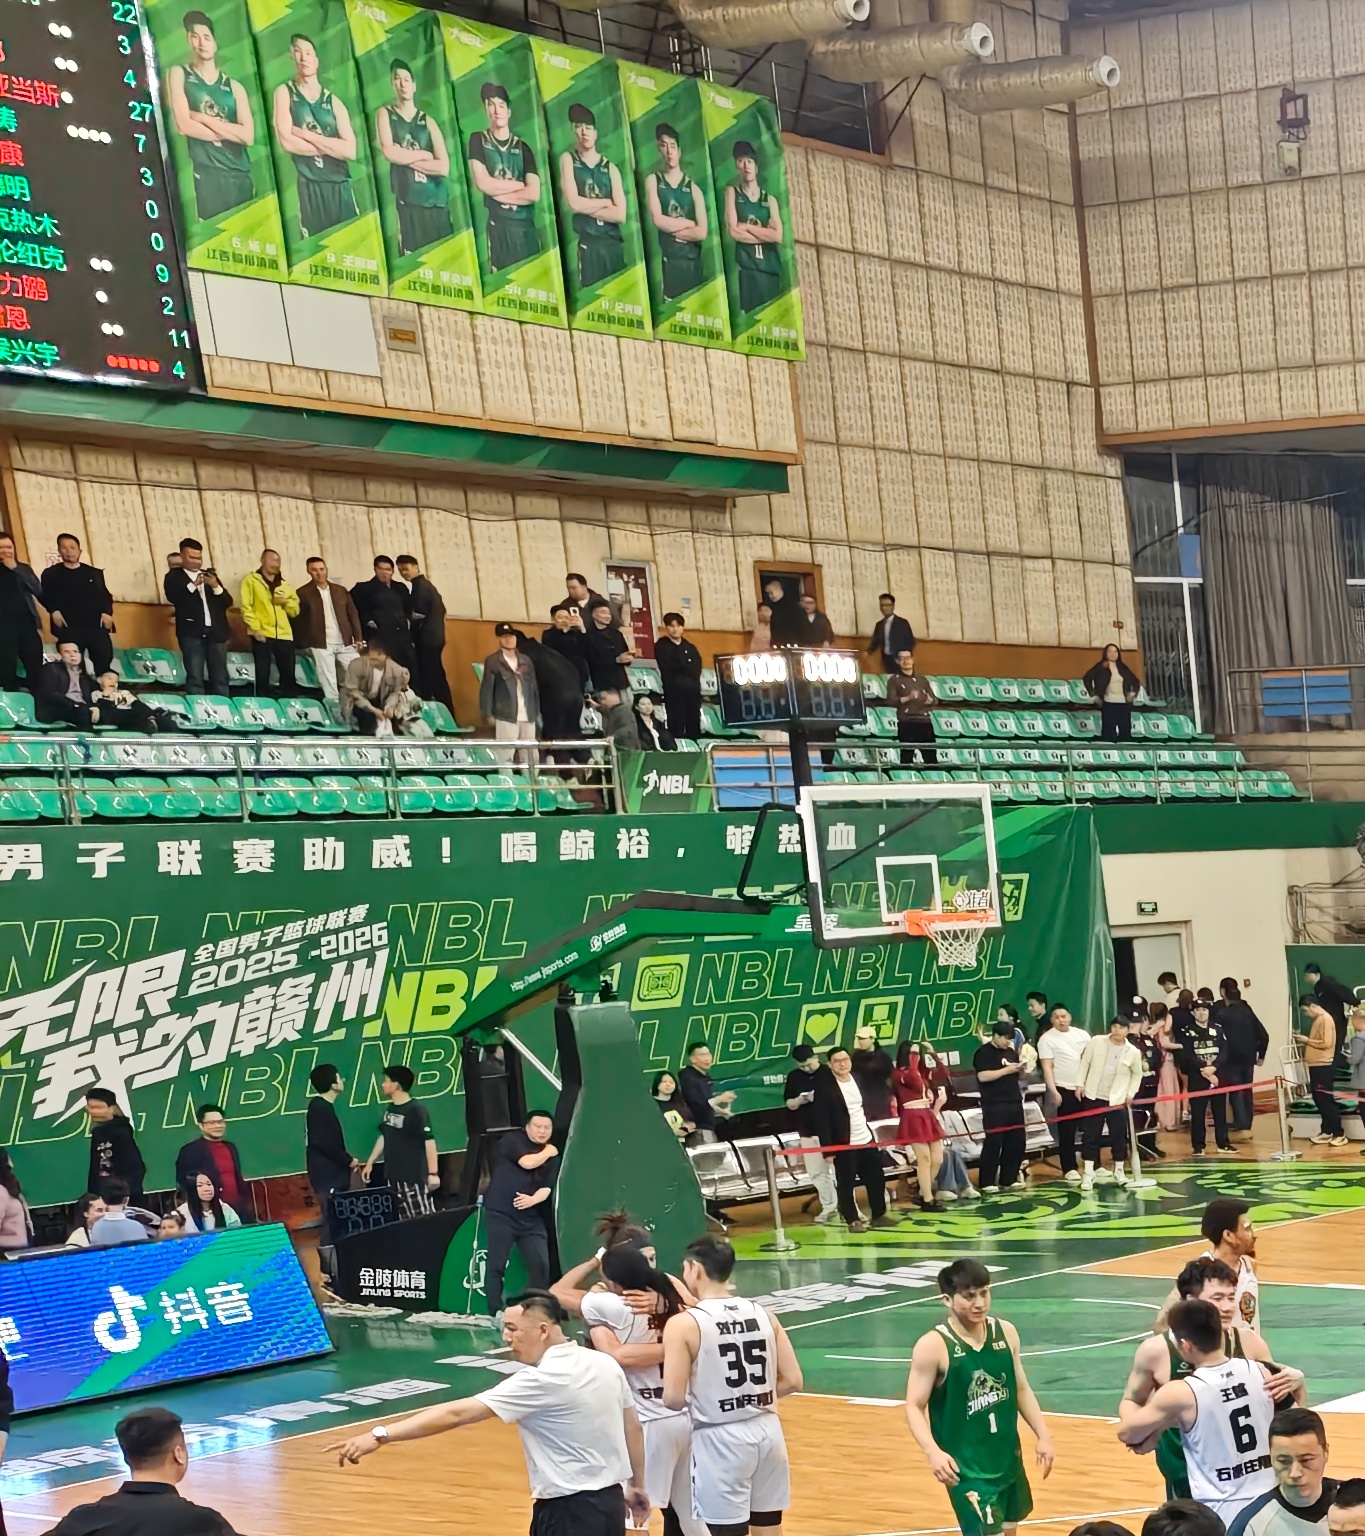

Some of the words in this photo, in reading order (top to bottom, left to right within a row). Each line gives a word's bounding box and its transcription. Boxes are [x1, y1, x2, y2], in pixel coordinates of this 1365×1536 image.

[118, 35, 131, 54] 3
[124, 69, 136, 88] 4
[129, 101, 153, 123] 27
[134, 133, 147, 153] 7
[140, 167, 153, 187] 3
[155, 264, 169, 283] 9
[161, 296, 175, 316] 2
[0, 304, 31, 331] 恩
[168, 328, 191, 350] 11
[172, 360, 186, 379] 4
[659, 774, 694, 795] NBL
[193, 903, 371, 964] 全国男子篮球联赛
[388, 897, 528, 968] NBL
[693, 948, 803, 1007] NBL
[812, 943, 913, 996] NBL
[363, 965, 498, 1037] NB
[32, 949, 390, 1127] 我的赣州
[680, 1008, 792, 1070] NBL
[358, 1267, 427, 1290] 金陵体育
[159, 1282, 253, 1334] 抖音
[717, 1338, 768, 1389] 35
[988, 1412, 998, 1434] 1
[1228, 1403, 1258, 1454] 6
